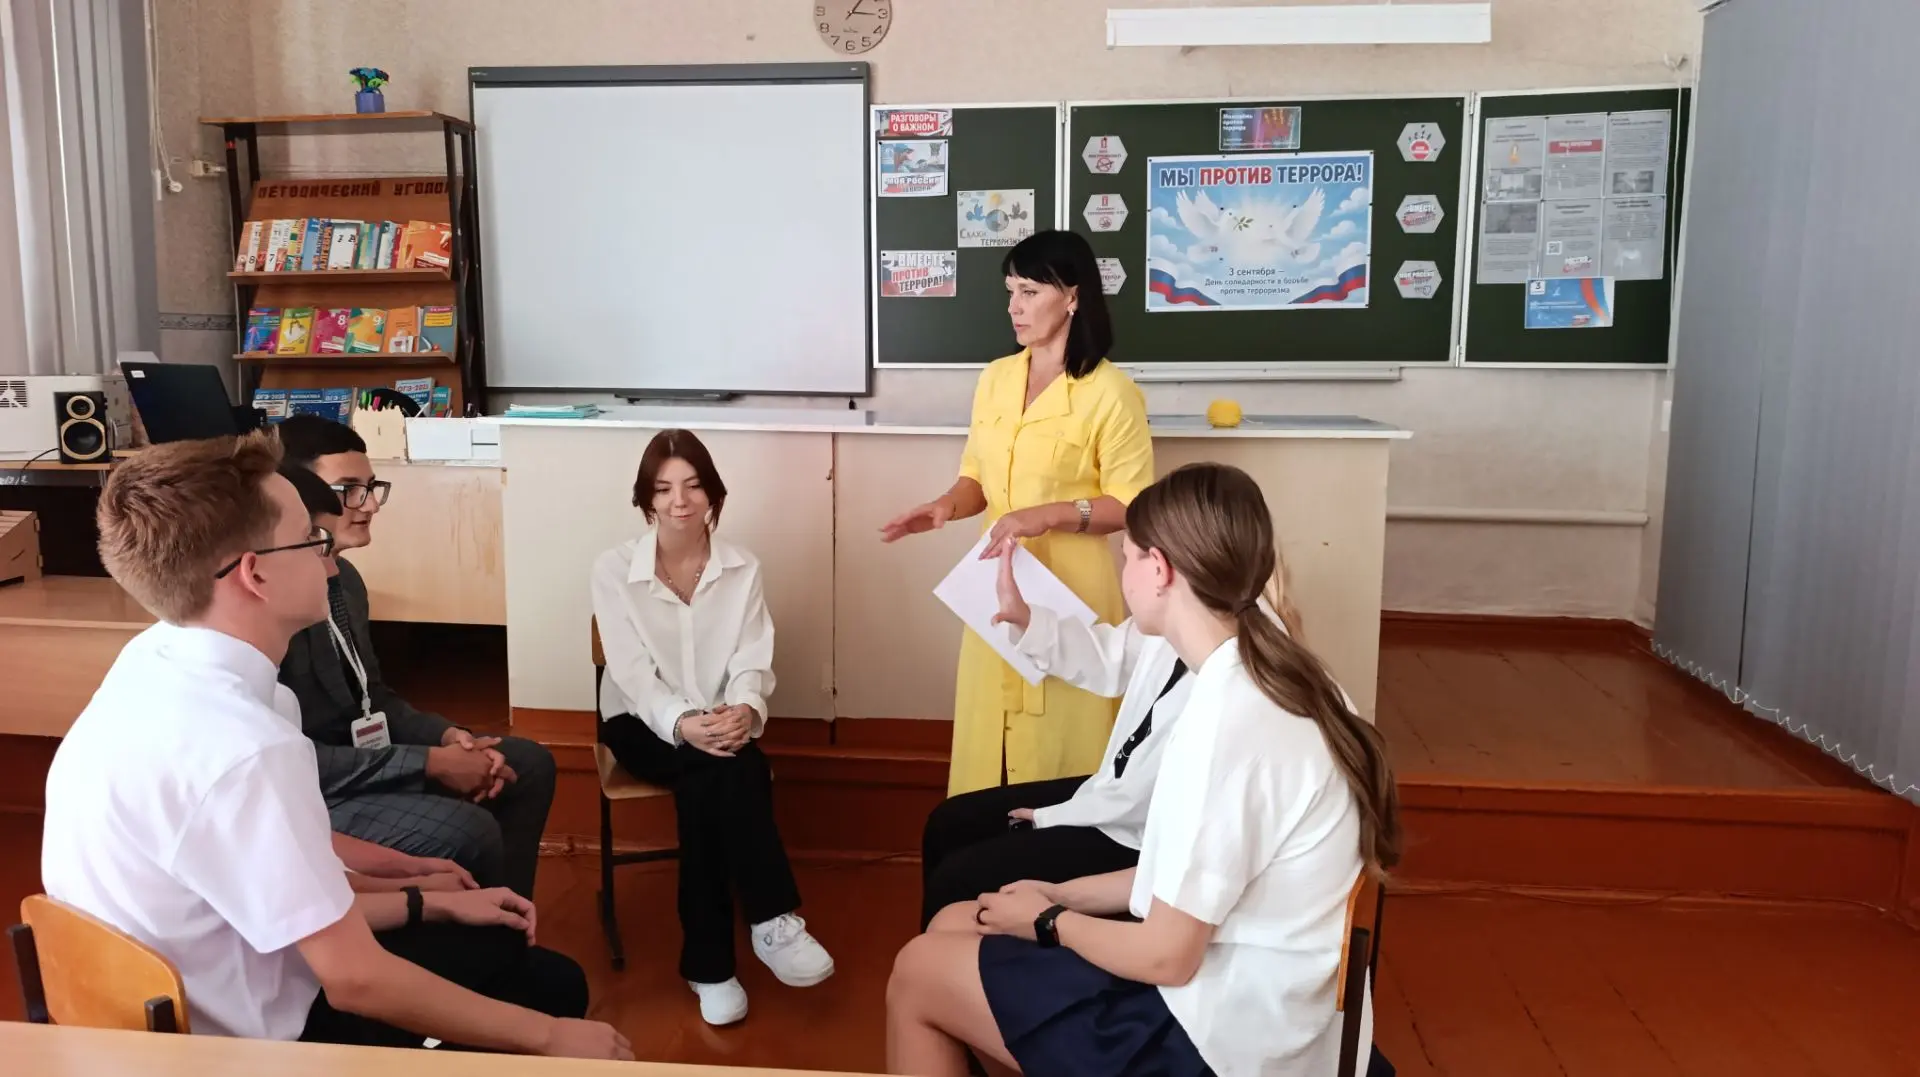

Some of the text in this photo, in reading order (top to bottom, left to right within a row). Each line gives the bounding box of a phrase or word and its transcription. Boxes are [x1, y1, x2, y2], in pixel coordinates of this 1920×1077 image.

[878, 8, 888, 19] 3
[820, 22, 829, 33] 8
[873, 25, 882, 35] 4
[831, 35, 840, 45] 7
[845, 40, 856, 51] 6
[861, 36, 871, 47] 5
[890, 113, 937, 123] РАЗГОВОРЫ
[892, 122, 935, 132] О ВАЖНОМ
[1160, 163, 1363, 187] МЫ ПРОТИВ ТЕРРОРА!
[258, 180, 448, 199] МЕТОДИЧЕСКИЙ УГОЛО
[896, 252, 946, 268] ВМЕСТЕ
[892, 267, 929, 283] ПРОТИВ
[1229, 267, 1235, 277] 3
[1236, 267, 1276, 278] сентября
[900, 275, 945, 293] ТЕРРОРА!
[1204, 278, 1223, 286] День
[1224, 278, 1276, 287] солидарности
[1283, 276, 1309, 285] борьбе
[1220, 286, 1290, 296] против терроризма
[337, 314, 347, 326] 8
[373, 315, 383, 327] 9
